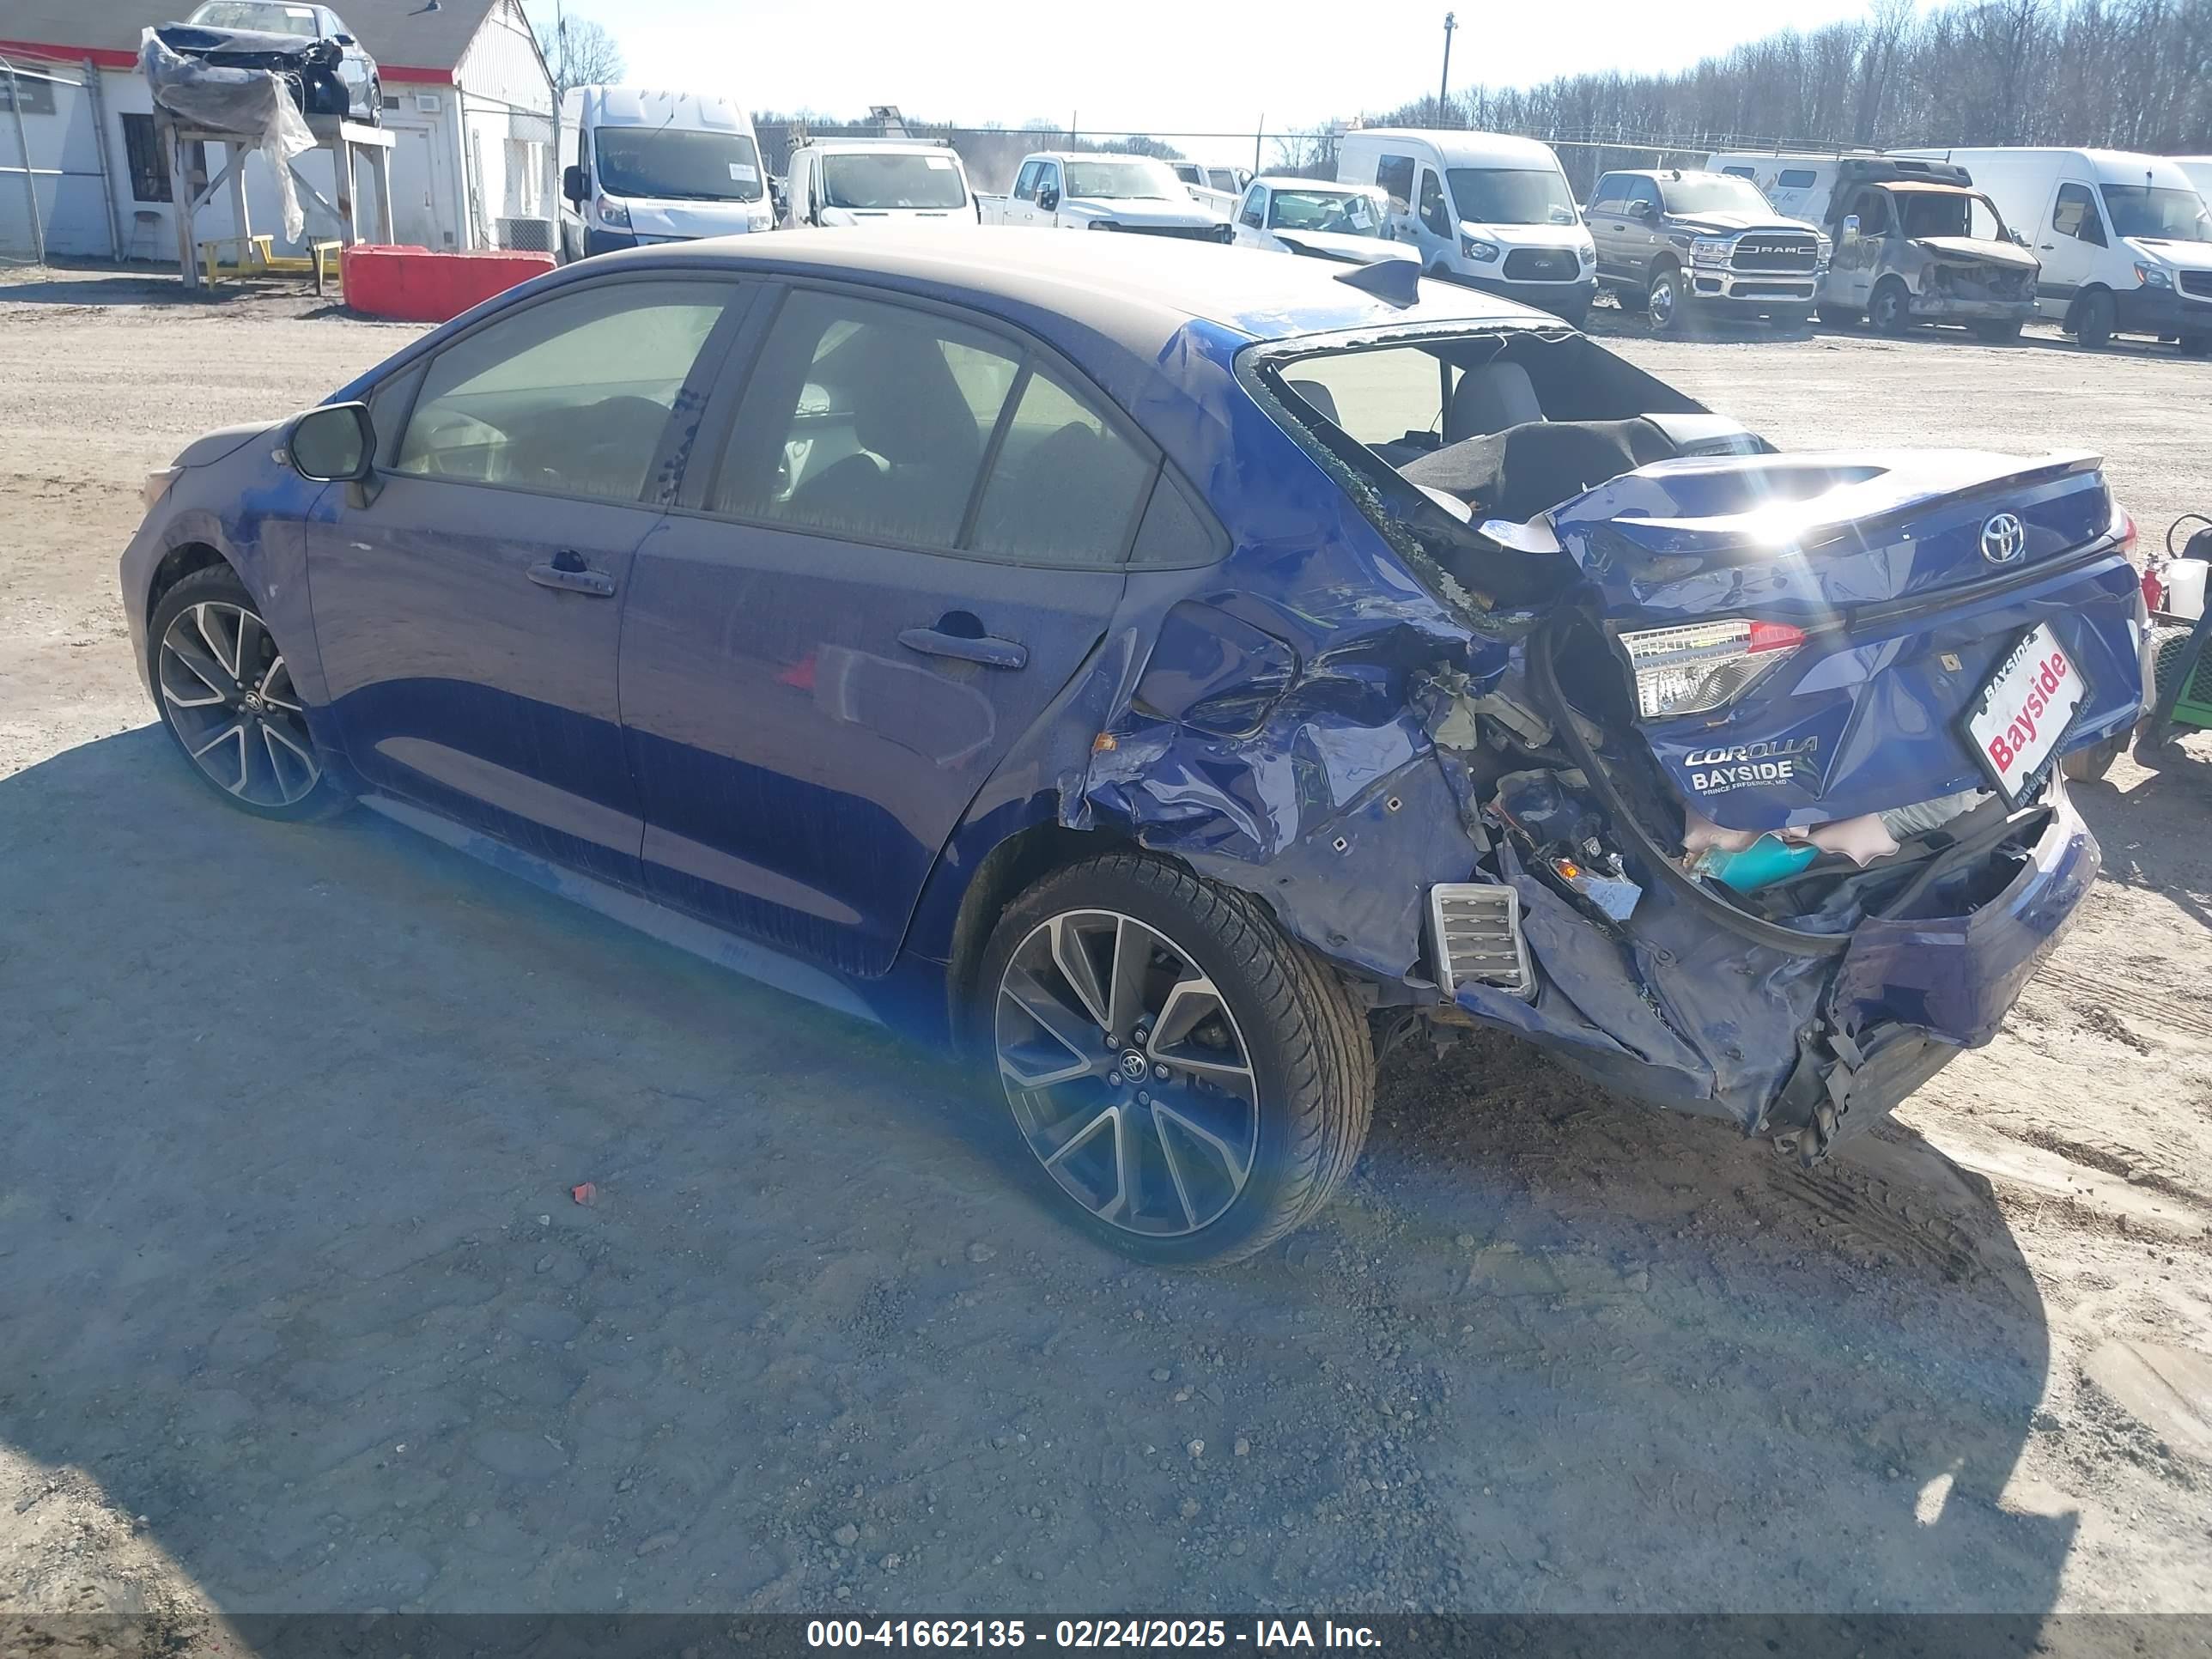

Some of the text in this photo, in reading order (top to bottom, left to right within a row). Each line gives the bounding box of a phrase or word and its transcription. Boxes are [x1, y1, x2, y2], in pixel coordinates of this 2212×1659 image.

[1984, 634, 2036, 701] BAYSIDE
[1988, 652, 2066, 774] Bayside
[1685, 736, 1819, 767] COROLLA
[1692, 760, 1794, 791] BAYSIDE
[1703, 784, 1731, 797] PRINCE
